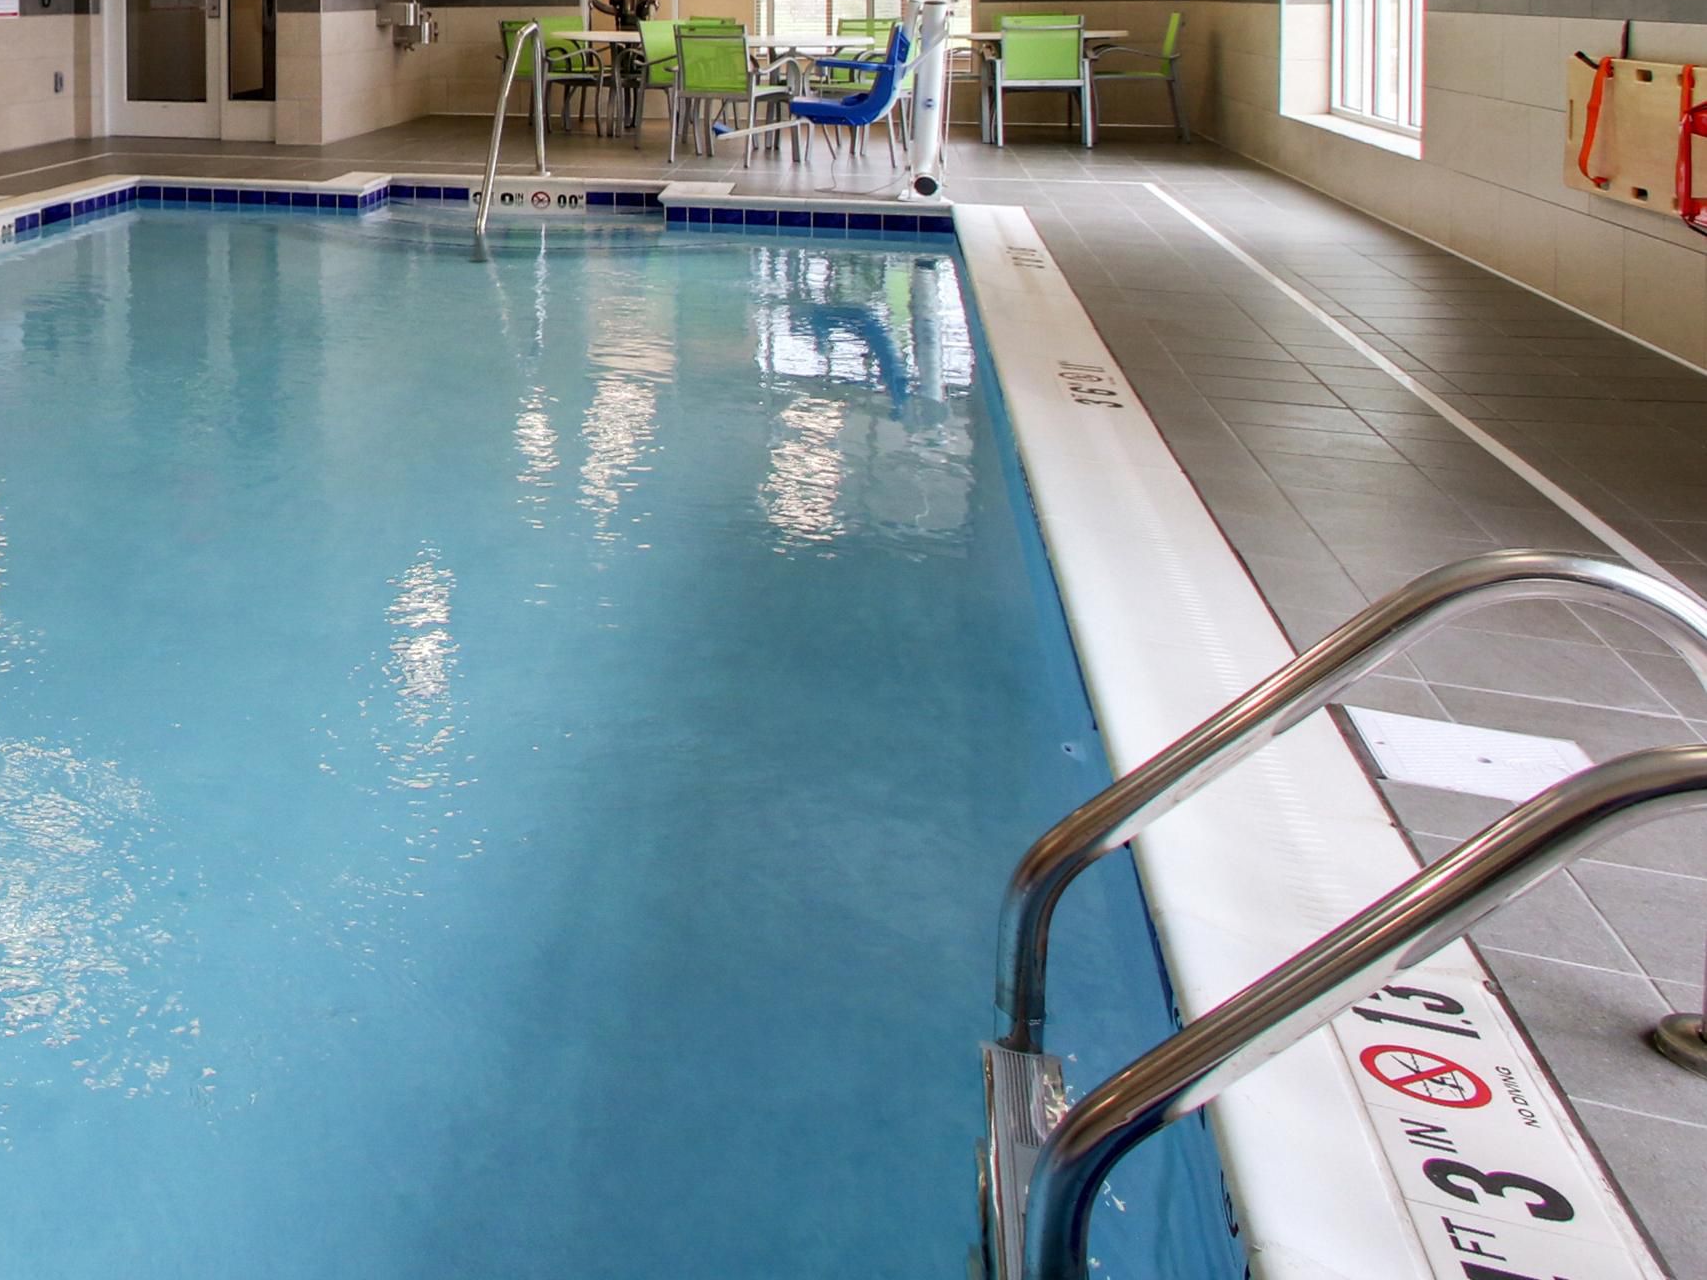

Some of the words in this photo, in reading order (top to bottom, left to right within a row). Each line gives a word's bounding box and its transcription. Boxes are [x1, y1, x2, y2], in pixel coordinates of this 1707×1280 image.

[1495, 1065, 1530, 1107] DIVING
[1399, 1117, 1458, 1154] IN
[1517, 1108, 1542, 1128] NO
[1422, 1157, 1575, 1222] 3
[1441, 1216, 1507, 1261] FT
